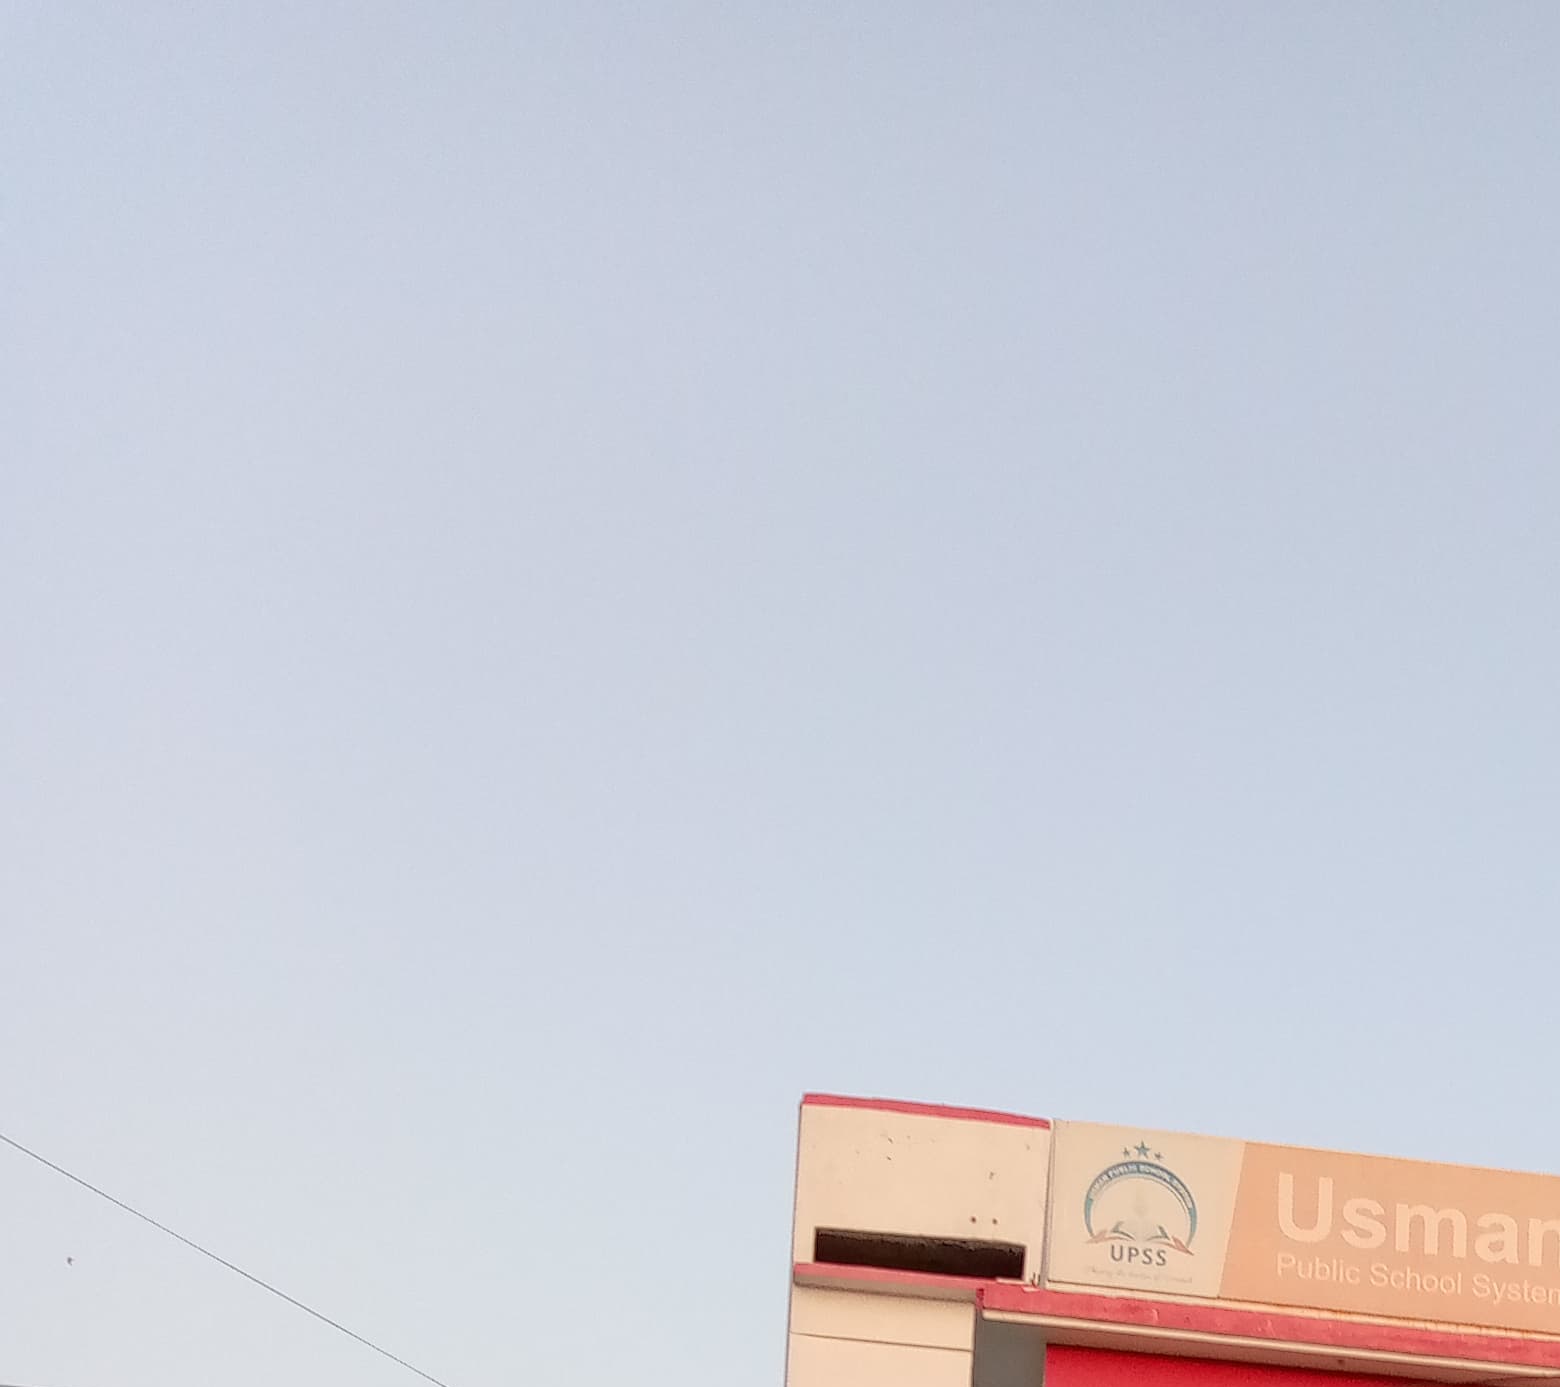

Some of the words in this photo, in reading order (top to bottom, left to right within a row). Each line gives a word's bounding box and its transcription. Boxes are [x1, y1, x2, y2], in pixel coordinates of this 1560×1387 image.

[1110, 1244, 1167, 1266] UPSS
[1276, 1252, 1361, 1284] Public
[1369, 1263, 1463, 1295] School
